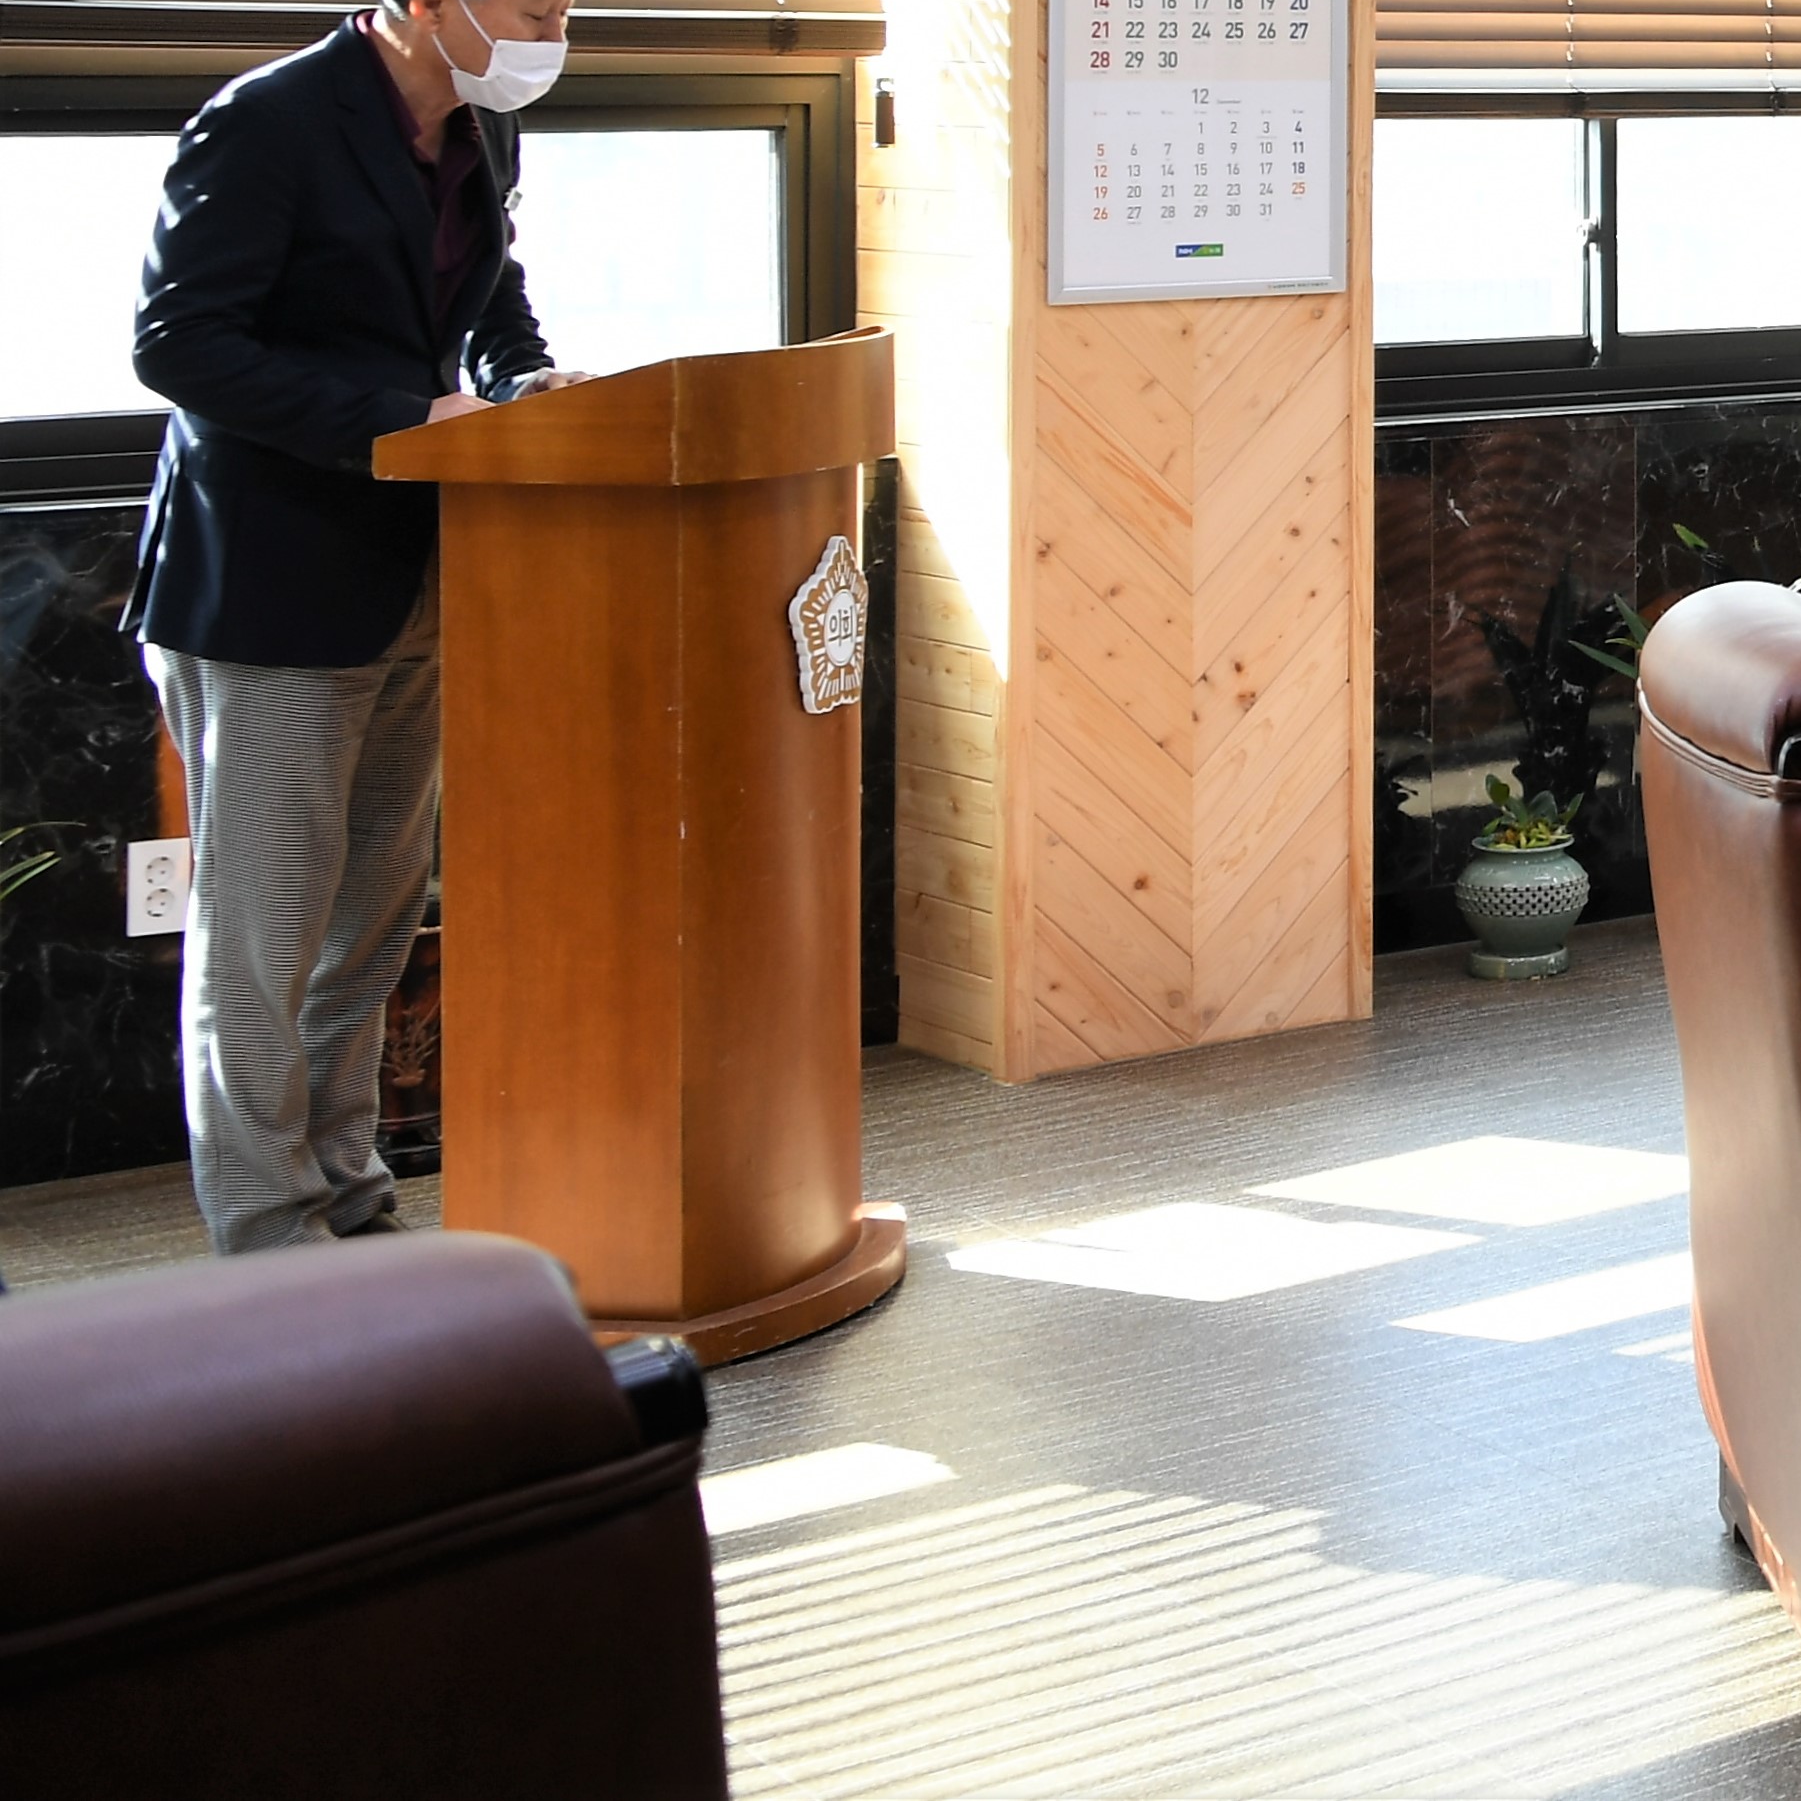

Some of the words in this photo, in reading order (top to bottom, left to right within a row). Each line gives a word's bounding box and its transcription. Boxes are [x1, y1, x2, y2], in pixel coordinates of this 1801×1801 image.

[1091, 20, 1109, 39] 21
[1125, 21, 1145, 39] 22
[1158, 21, 1178, 39] 23
[1224, 21, 1244, 39] 25
[1257, 22, 1277, 40] 26
[1289, 22, 1309, 40] 27
[1090, 50, 1111, 69] 28
[1124, 50, 1145, 69] 29
[1157, 50, 1178, 69] 30
[1191, 87, 1210, 105] 12
[1198, 121, 1204, 135] 1
[1230, 121, 1238, 134] 2
[1262, 120, 1270, 134] 3
[1294, 120, 1303, 133] 4
[1097, 143, 1105, 157] 5
[1130, 143, 1138, 156] 6
[1163, 142, 1172, 156] 7
[1196, 142, 1205, 156] 8
[1230, 141, 1238, 155] 9
[1259, 141, 1273, 155] 10
[1292, 141, 1304, 154] 11
[1093, 164, 1108, 179] 12
[1127, 164, 1141, 178] 13
[1161, 163, 1175, 177] 14
[1194, 162, 1208, 176] 15
[1227, 162, 1241, 176] 16
[1259, 161, 1274, 175] 17
[1292, 161, 1306, 175] 18
[1094, 185, 1108, 199] 19
[1126, 185, 1142, 199] 20
[1161, 184, 1175, 198] 21
[1193, 183, 1209, 197] 22
[1226, 183, 1241, 197] 23
[1291, 181, 1306, 195] 25
[1093, 207, 1109, 221] 26
[1126, 206, 1142, 220] 27
[1160, 205, 1176, 219] 28
[1193, 204, 1209, 218] 29
[1225, 203, 1241, 217] 30
[1259, 202, 1273, 216] 31
[828, 605, 854, 646] 의회
